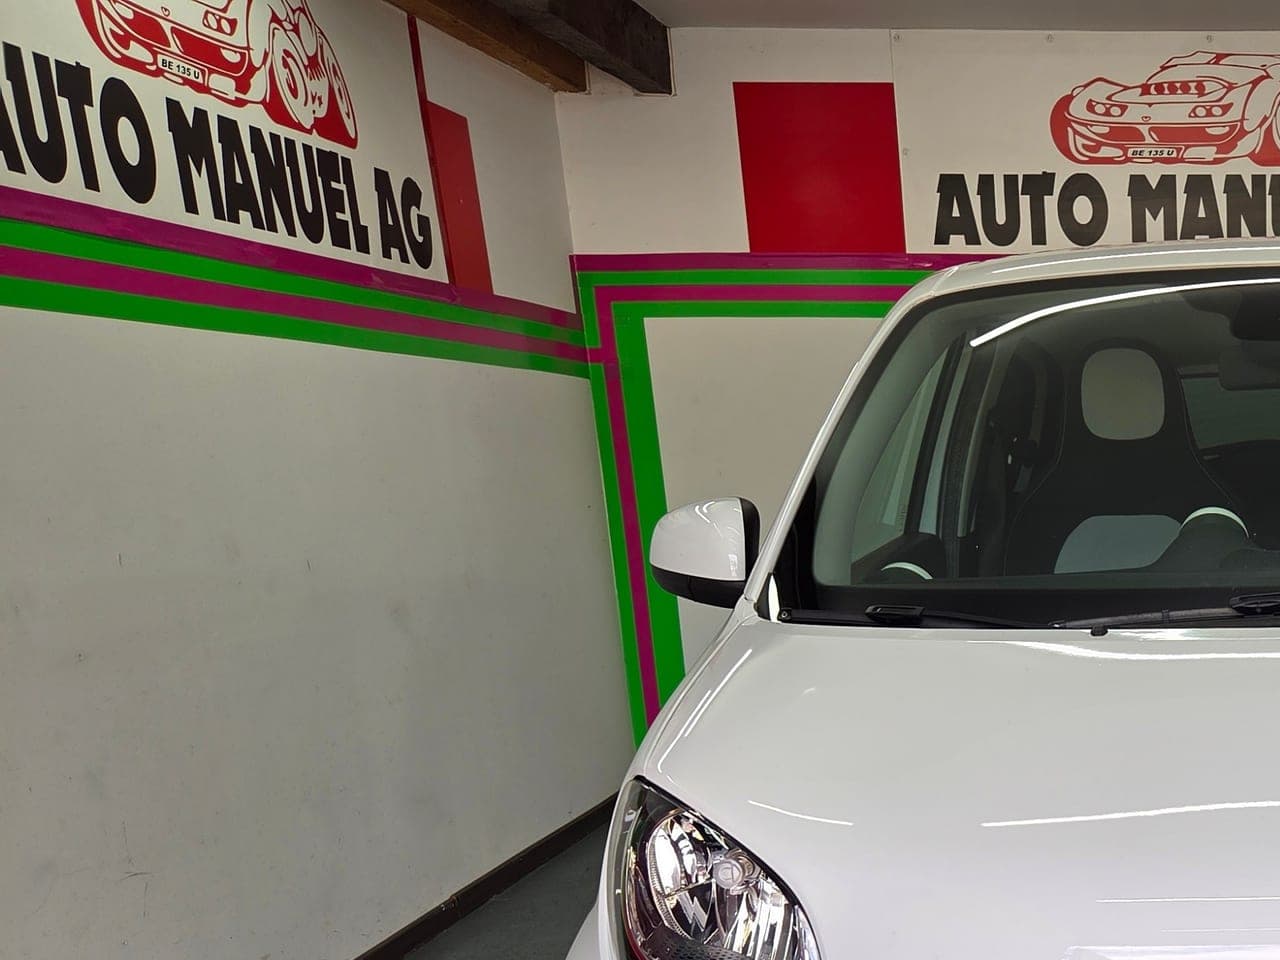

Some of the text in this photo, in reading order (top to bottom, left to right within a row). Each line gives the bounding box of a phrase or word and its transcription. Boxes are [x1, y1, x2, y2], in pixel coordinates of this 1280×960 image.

[161, 58, 200, 79] BE 135 U
[165, 97, 369, 255] MANUEL
[374, 168, 433, 270] AG
[934, 171, 1108, 246] AUTO
